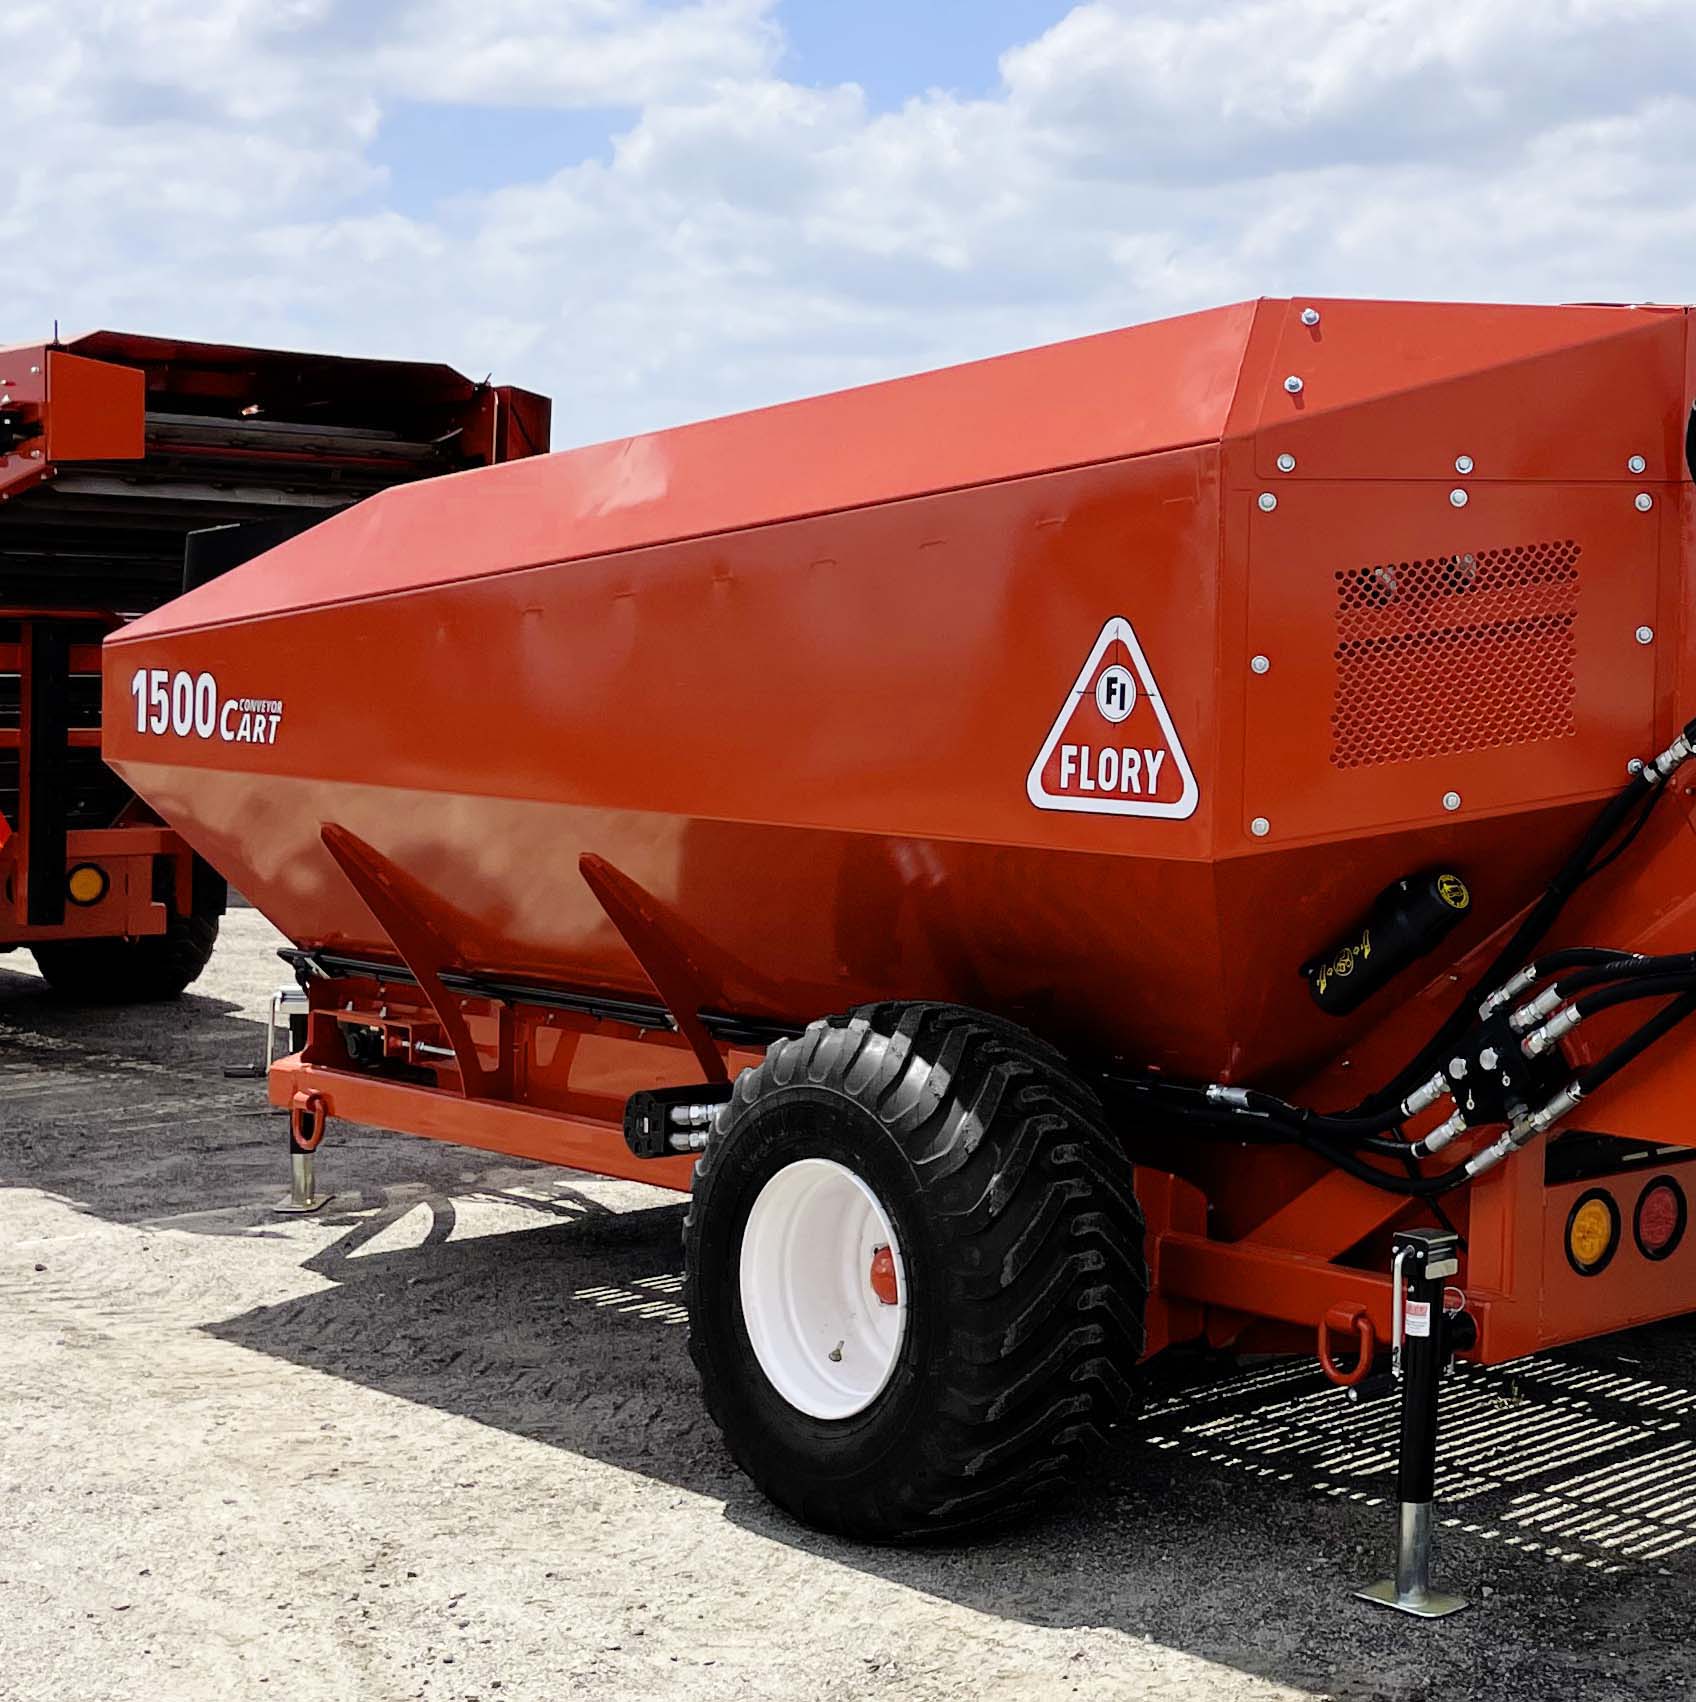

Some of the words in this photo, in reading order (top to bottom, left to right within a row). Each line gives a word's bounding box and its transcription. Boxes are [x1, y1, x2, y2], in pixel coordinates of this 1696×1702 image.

[131, 668, 217, 739] 1500
[219, 699, 281, 745] CART
[238, 698, 282, 714] CONVEYOR
[1059, 744, 1165, 795] FLORY
